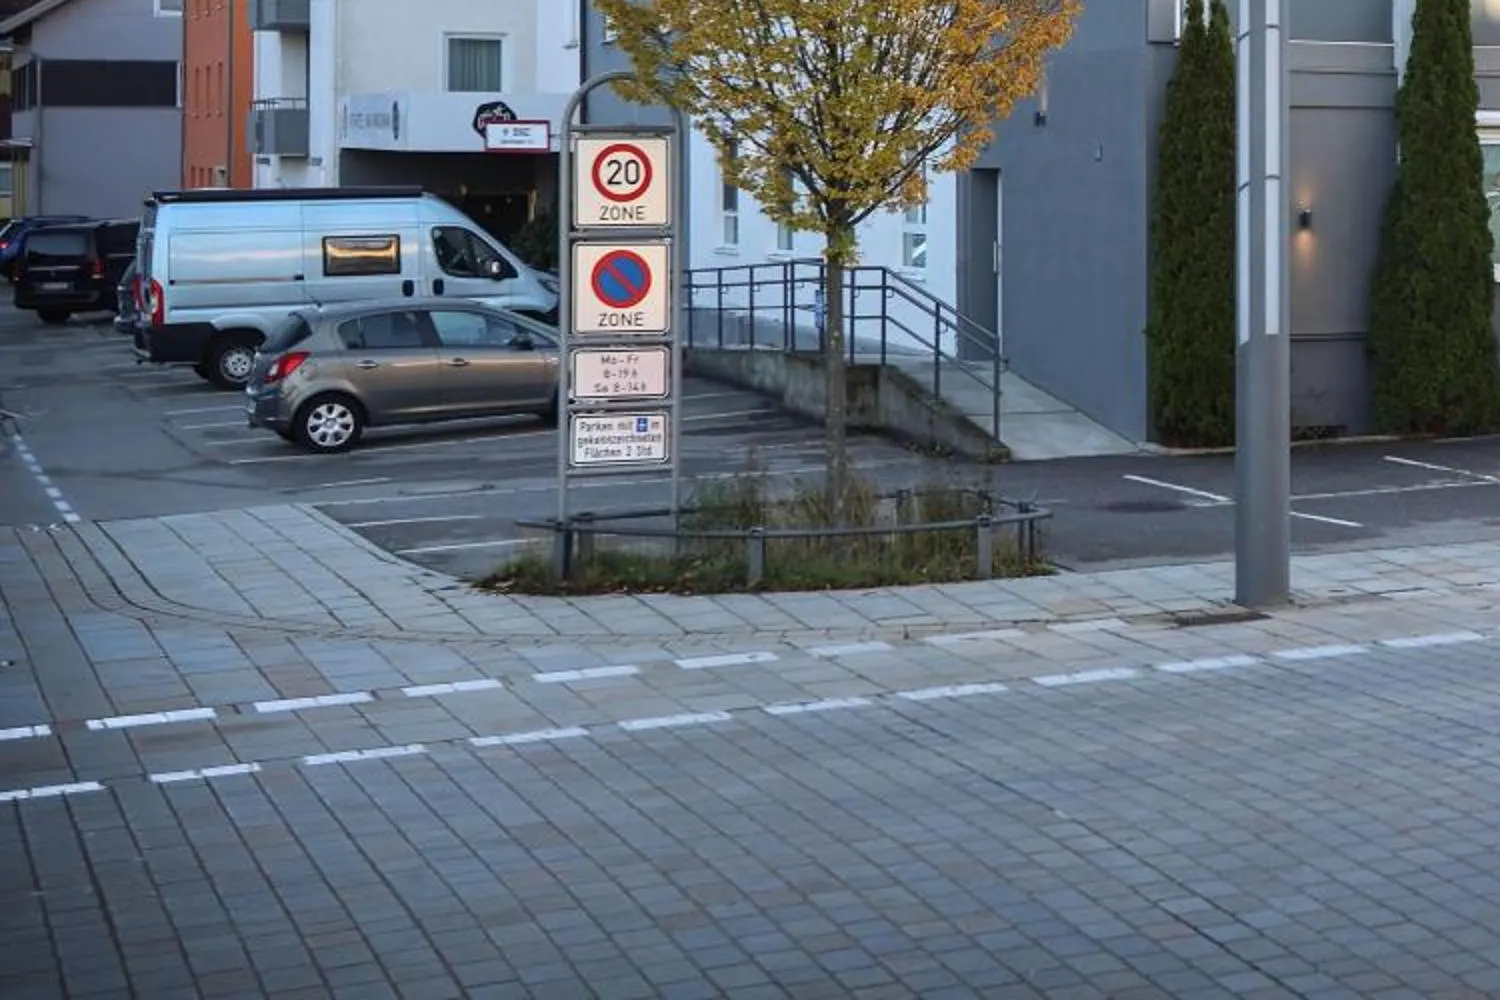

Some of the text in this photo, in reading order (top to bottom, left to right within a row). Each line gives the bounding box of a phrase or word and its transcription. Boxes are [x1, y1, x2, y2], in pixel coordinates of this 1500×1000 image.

[606, 159, 640, 185] 20
[600, 205, 646, 221] ZONE
[598, 312, 645, 327] ZONE
[579, 421, 613, 432] Parken
